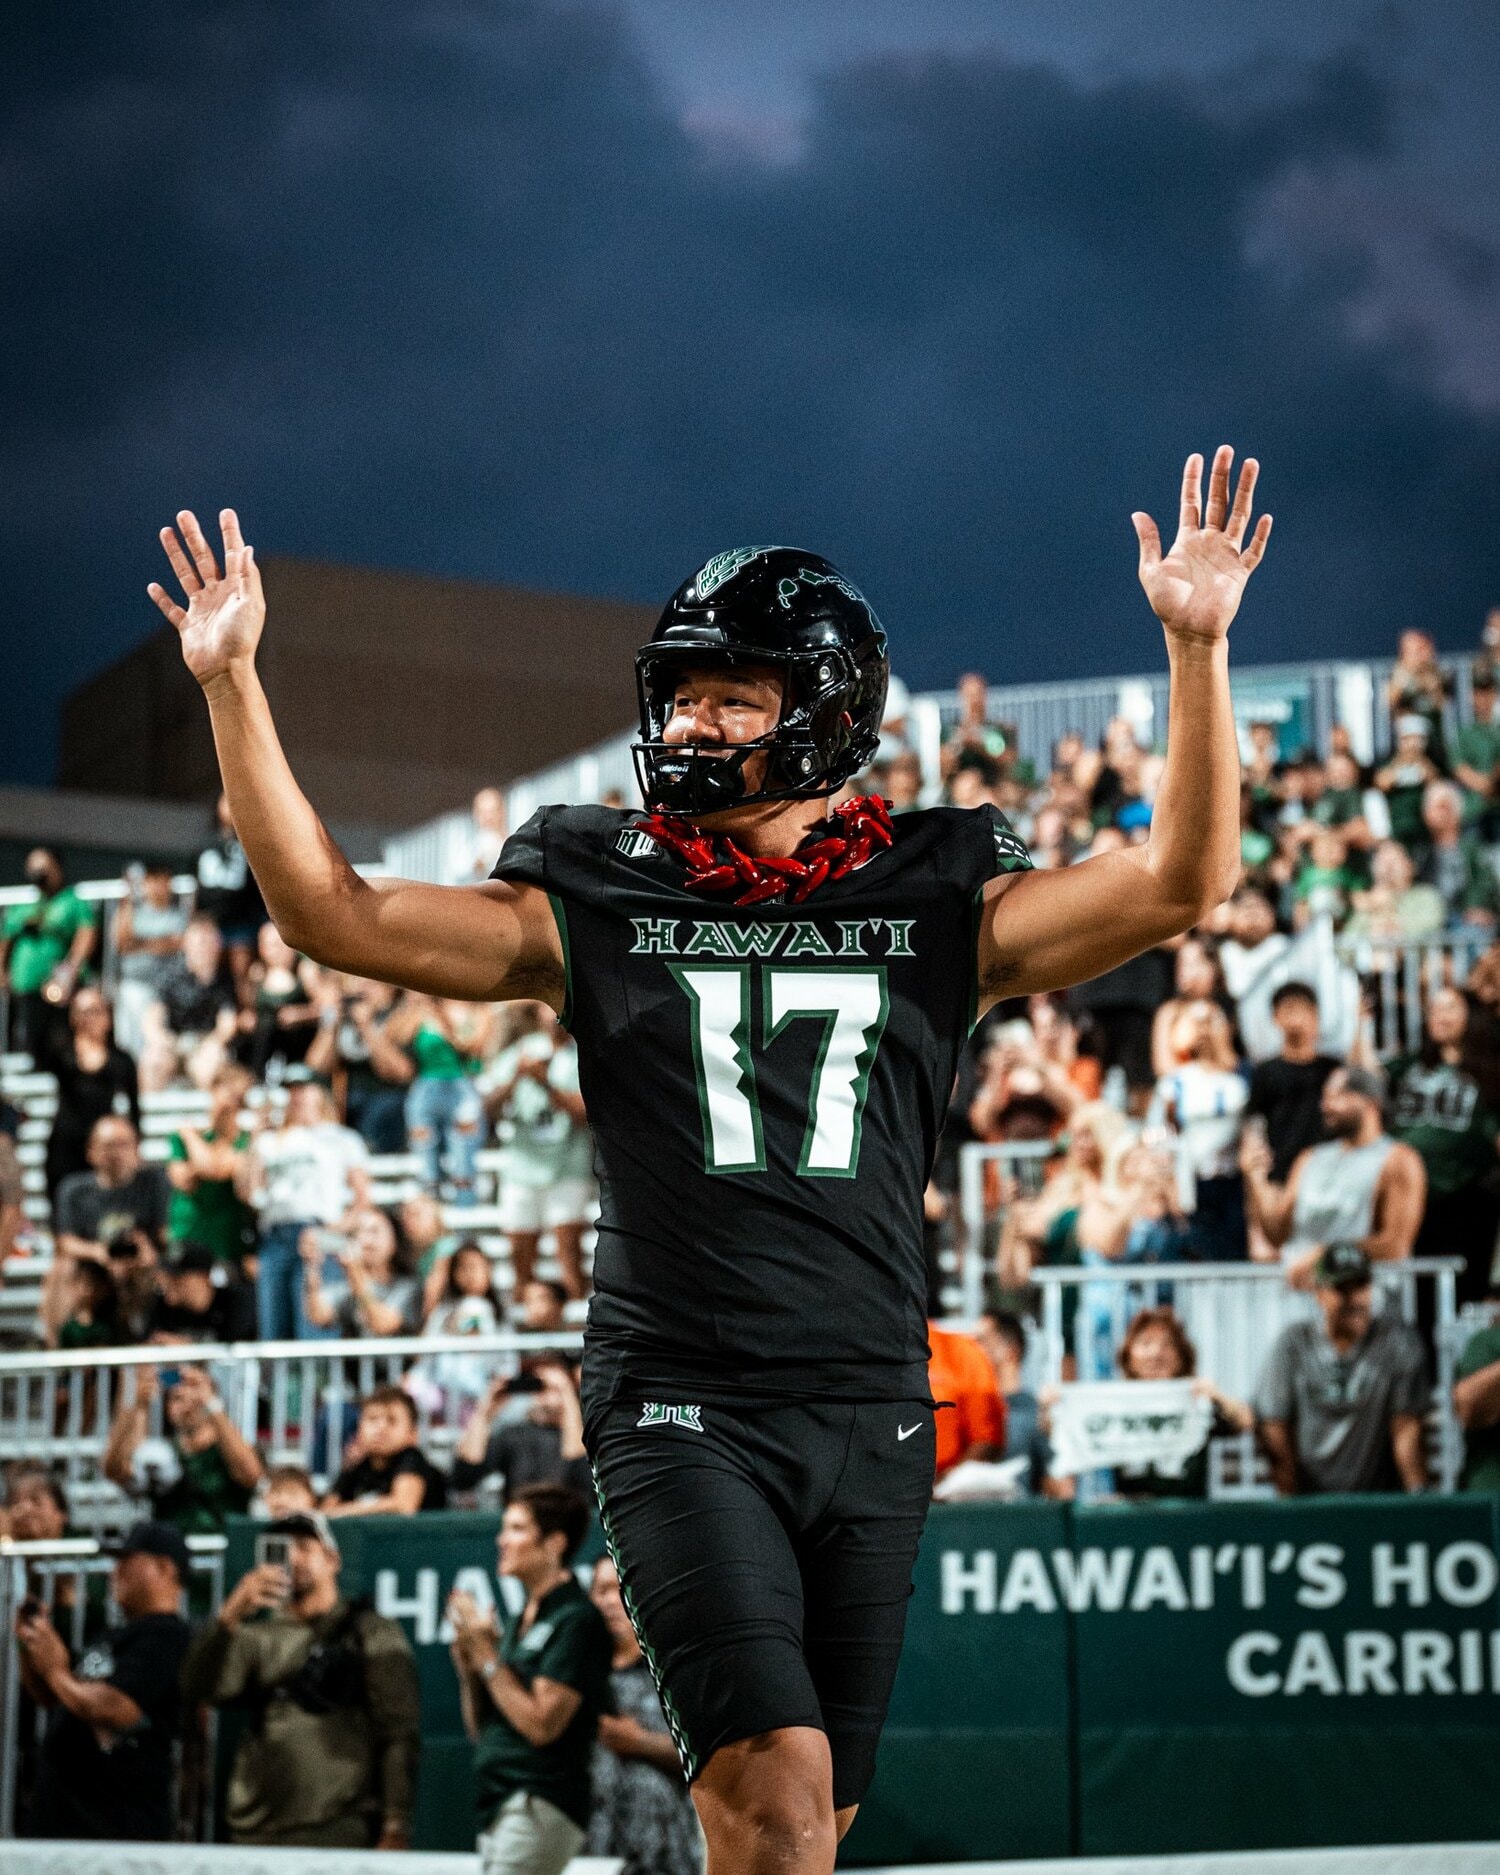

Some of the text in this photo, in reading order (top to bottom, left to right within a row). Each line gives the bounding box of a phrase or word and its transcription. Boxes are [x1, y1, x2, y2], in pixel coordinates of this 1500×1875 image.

[628, 918, 917, 957] HAWAI'I
[665, 962, 890, 1179] 17
[940, 1541, 1498, 1614] HAWAI'I'S HO
